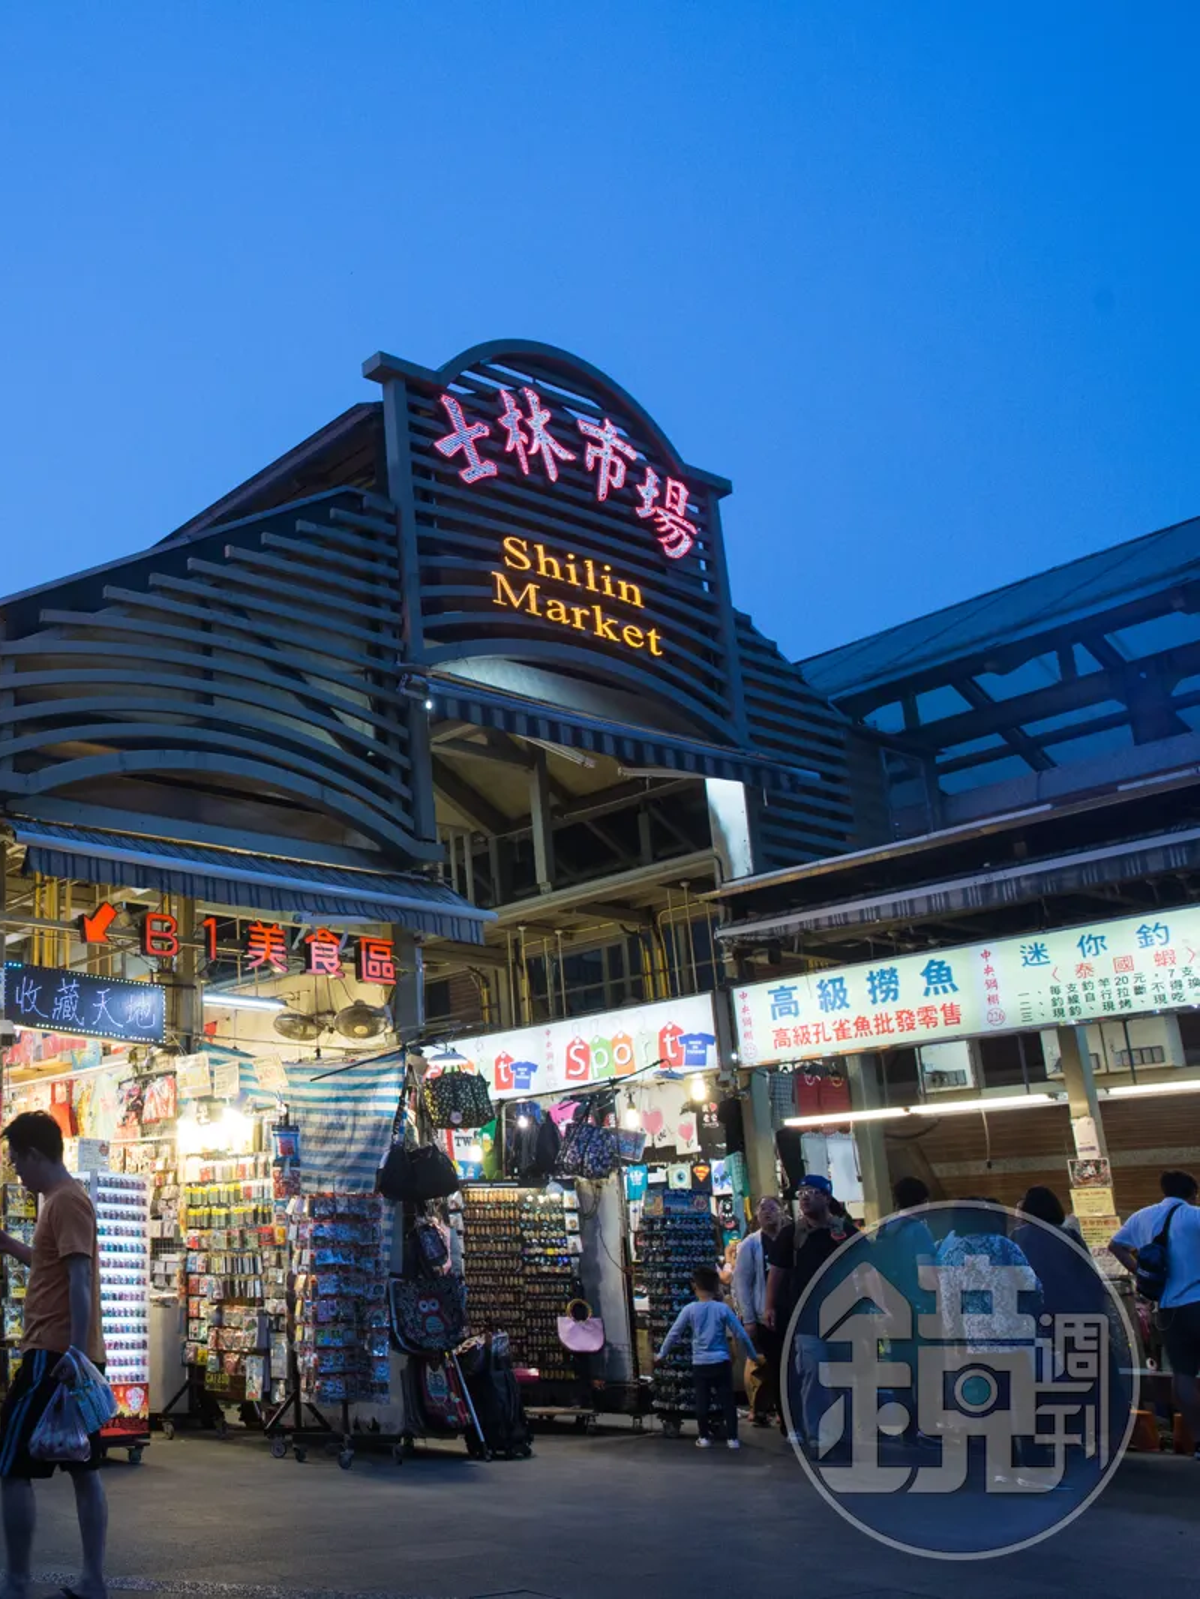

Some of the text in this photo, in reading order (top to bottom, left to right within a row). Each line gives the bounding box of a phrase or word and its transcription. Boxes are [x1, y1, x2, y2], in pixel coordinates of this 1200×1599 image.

[434, 386, 698, 560] 士林市場
[502, 535, 645, 608] Shilin
[491, 570, 664, 657] Market
[143, 912, 397, 986] B1美食區
[1019, 921, 1170, 968] 迷你釣
[13, 975, 157, 1029] 收藏天地
[767, 958, 960, 1021] 高級撈魚
[771, 1002, 962, 1050] 高級孔雀魚批發零售
